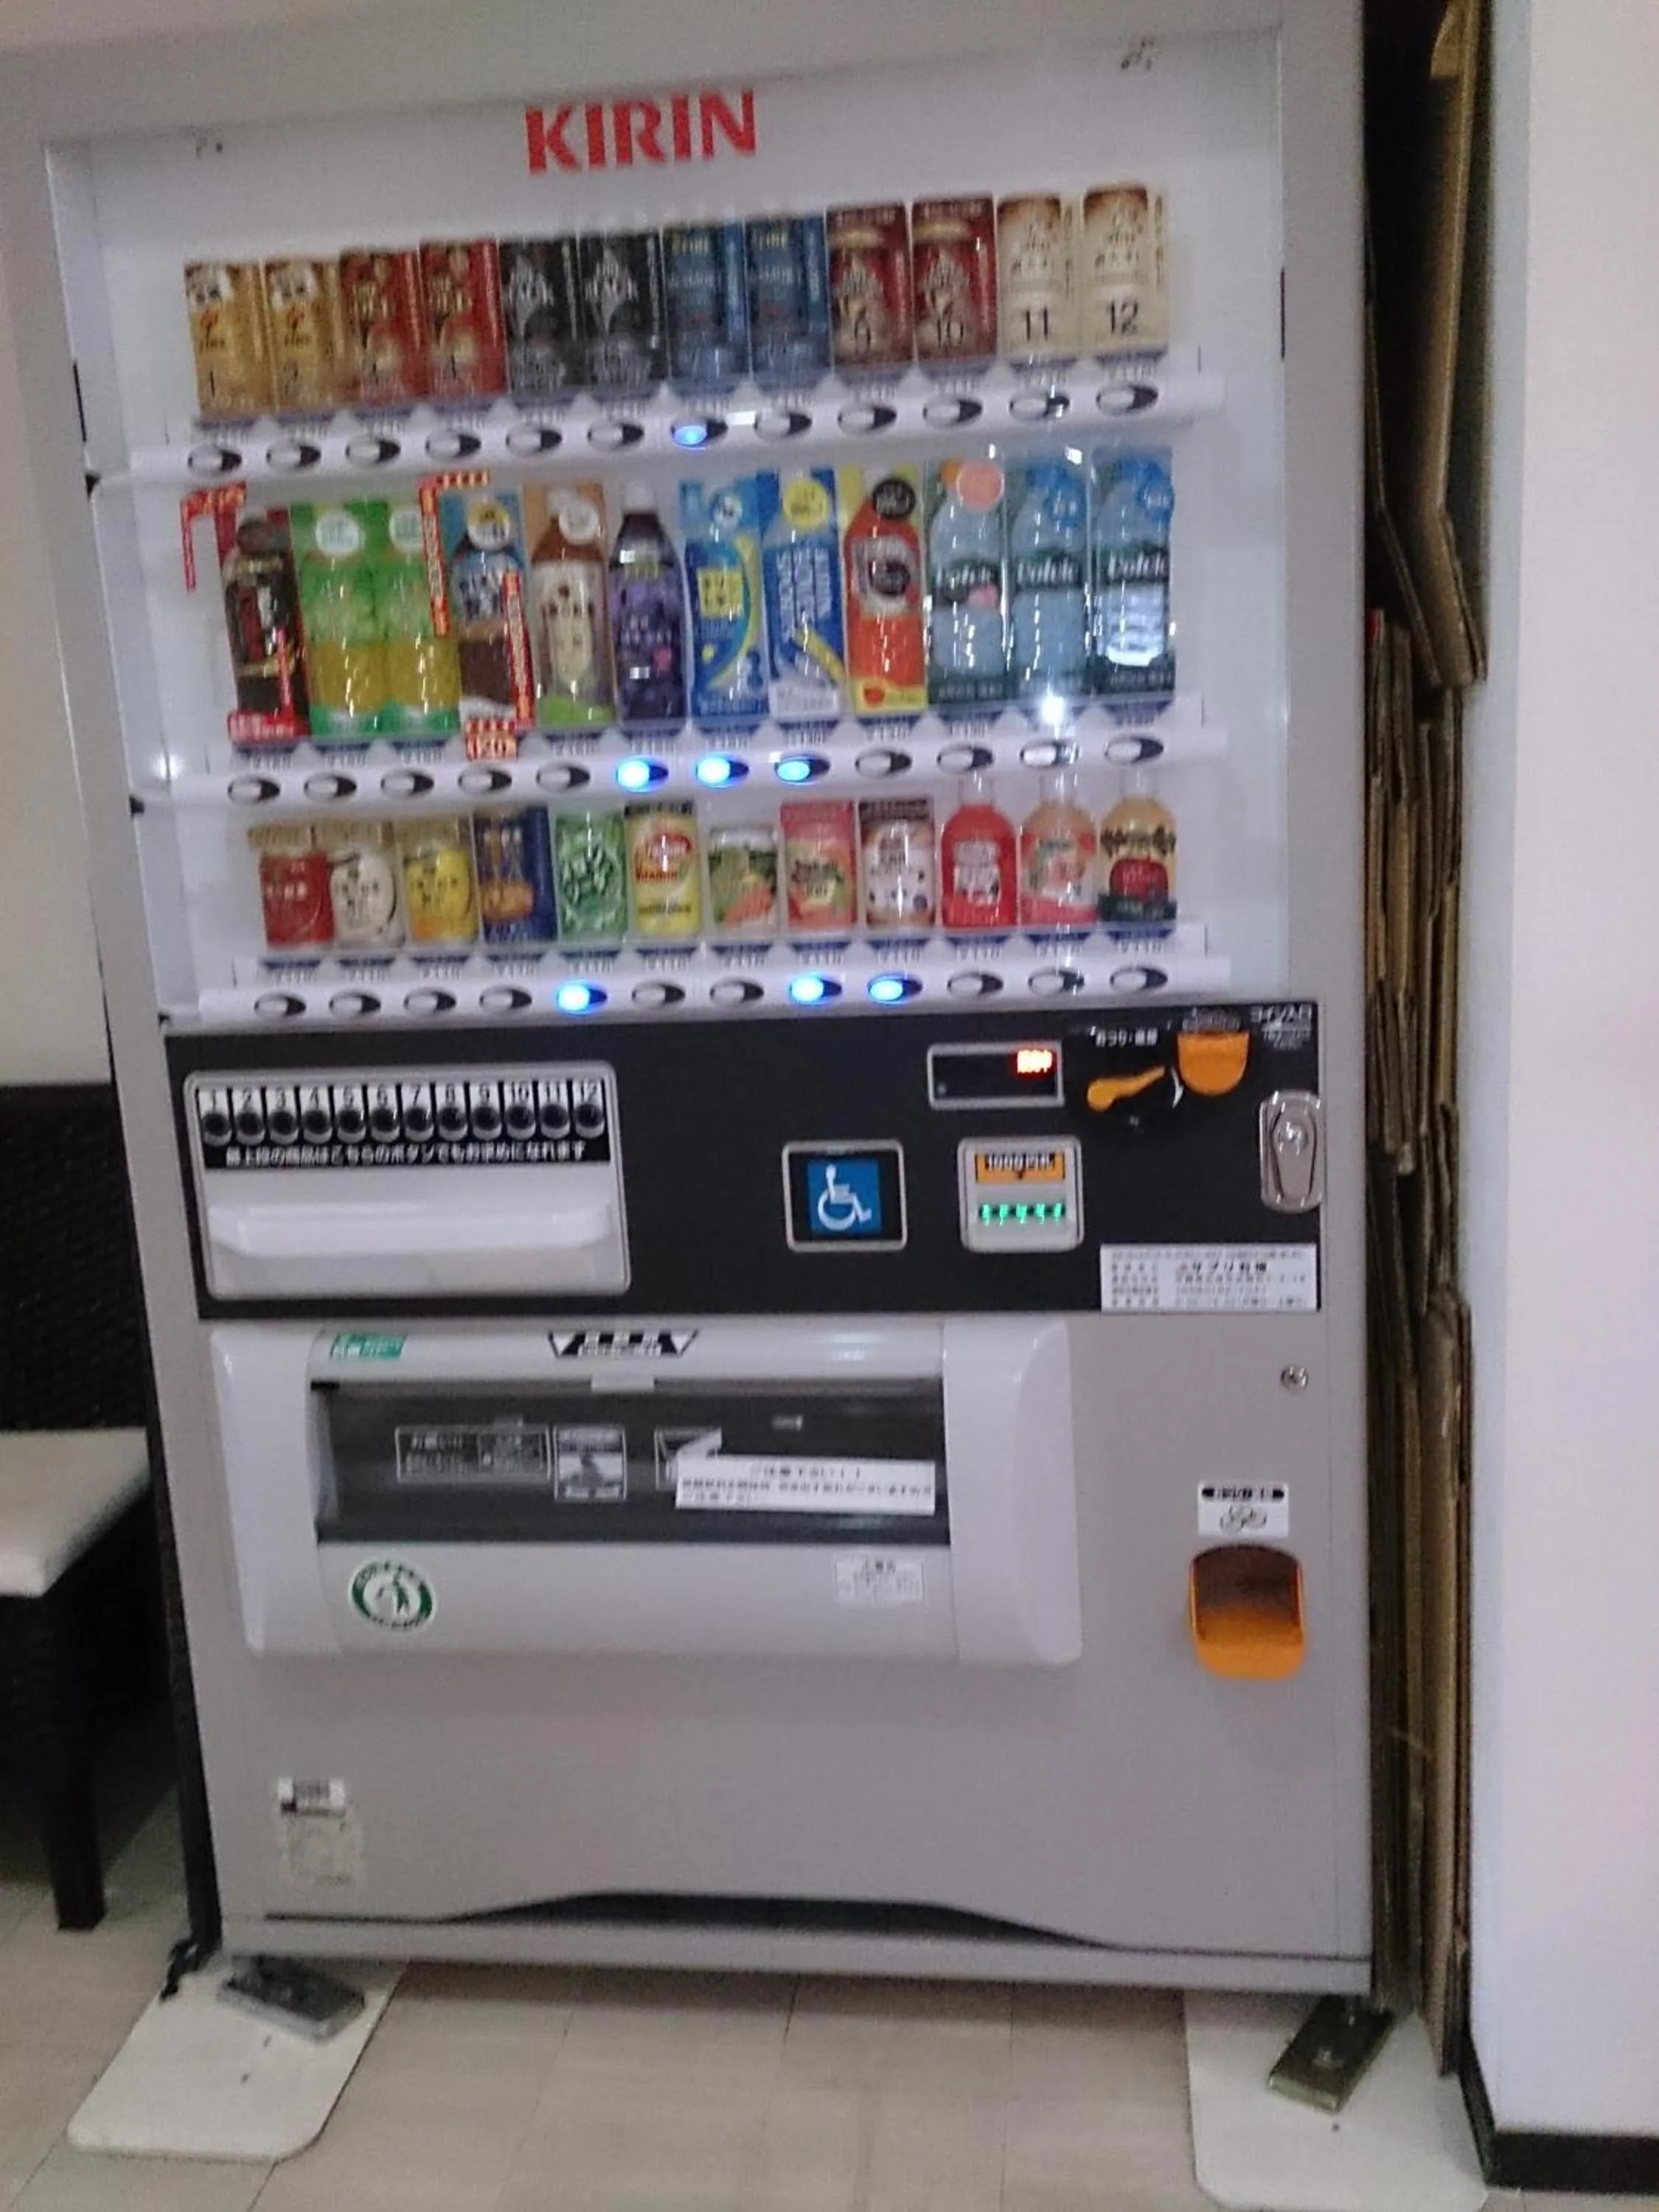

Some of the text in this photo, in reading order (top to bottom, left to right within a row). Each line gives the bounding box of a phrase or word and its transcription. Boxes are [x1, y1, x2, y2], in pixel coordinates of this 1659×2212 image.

[525, 88, 757, 174] KIRIN
[1023, 307, 1051, 342] 11
[1110, 299, 1138, 335] 12
[242, 1087, 253, 1110] 2
[309, 1086, 320, 1109] 4
[410, 1083, 422, 1106] 7
[480, 1082, 491, 1105] 9
[511, 1082, 530, 1105] 10
[543, 1081, 560, 1104] 11
[579, 1080, 599, 1103] 12
